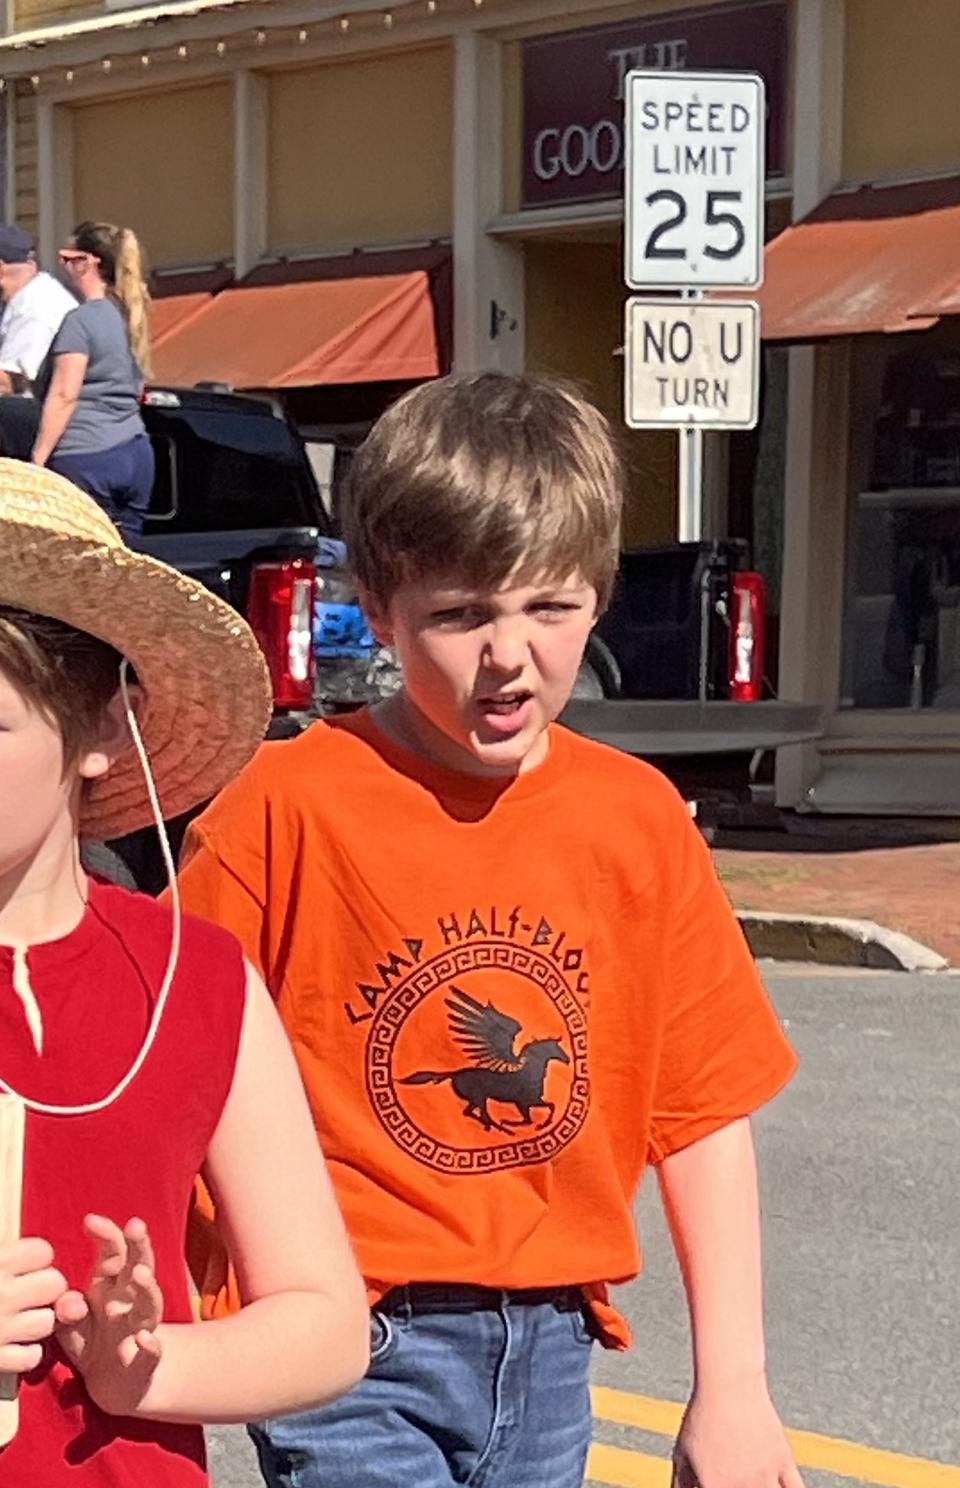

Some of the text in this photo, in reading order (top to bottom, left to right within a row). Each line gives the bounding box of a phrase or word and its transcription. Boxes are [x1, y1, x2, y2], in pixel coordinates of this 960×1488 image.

[641, 101, 750, 133] SPEED
[653, 146, 737, 176] LIMIT
[644, 189, 746, 262] 25
[643, 321, 743, 364] NO U
[656, 377, 729, 408] TURN
